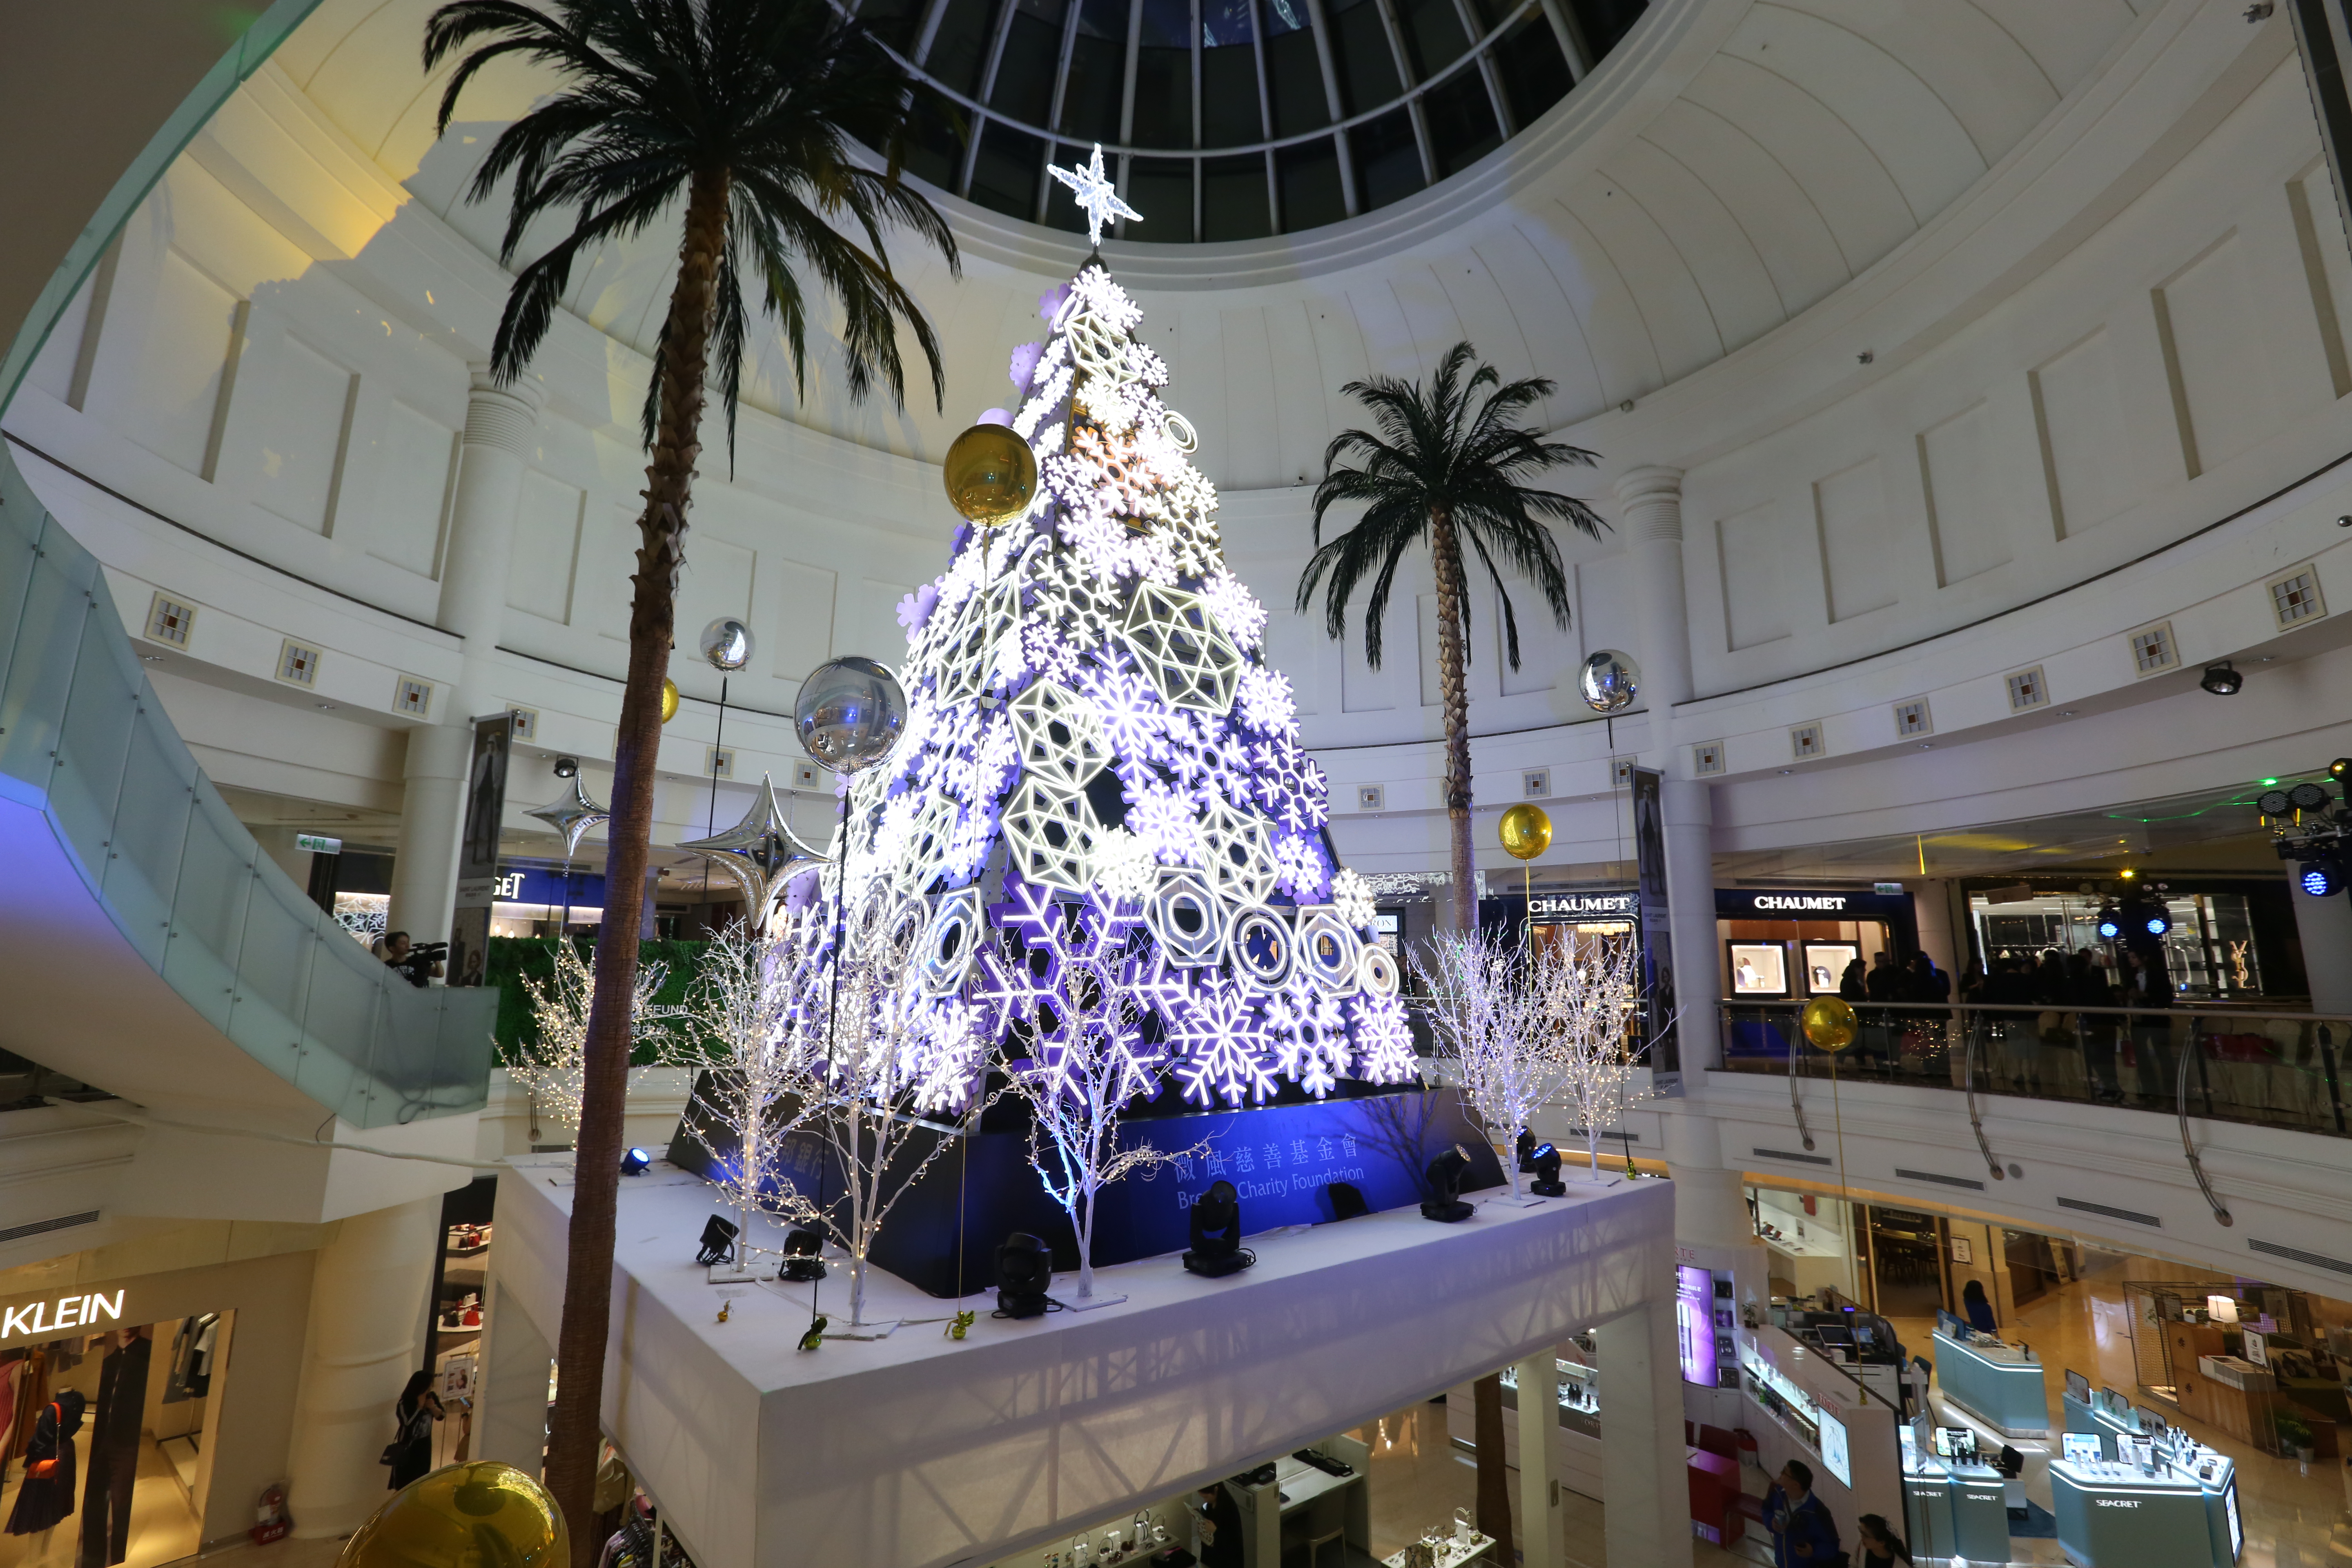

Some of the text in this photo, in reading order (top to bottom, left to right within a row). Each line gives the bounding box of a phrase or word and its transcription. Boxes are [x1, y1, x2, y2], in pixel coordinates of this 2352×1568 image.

[1528, 898, 1630, 912] CHAUMET
[1754, 896, 1846, 910] CHAUMET
[1174, 1133, 1357, 1183] 微風慈善基金會
[1237, 1178, 1288, 1200] Charity
[1292, 1166, 1365, 1190] Foundation
[1, 1289, 125, 1339] KLEIN
[1581, 1419, 1601, 1428] FORT
[2096, 1499, 2140, 1508] SEACRET
